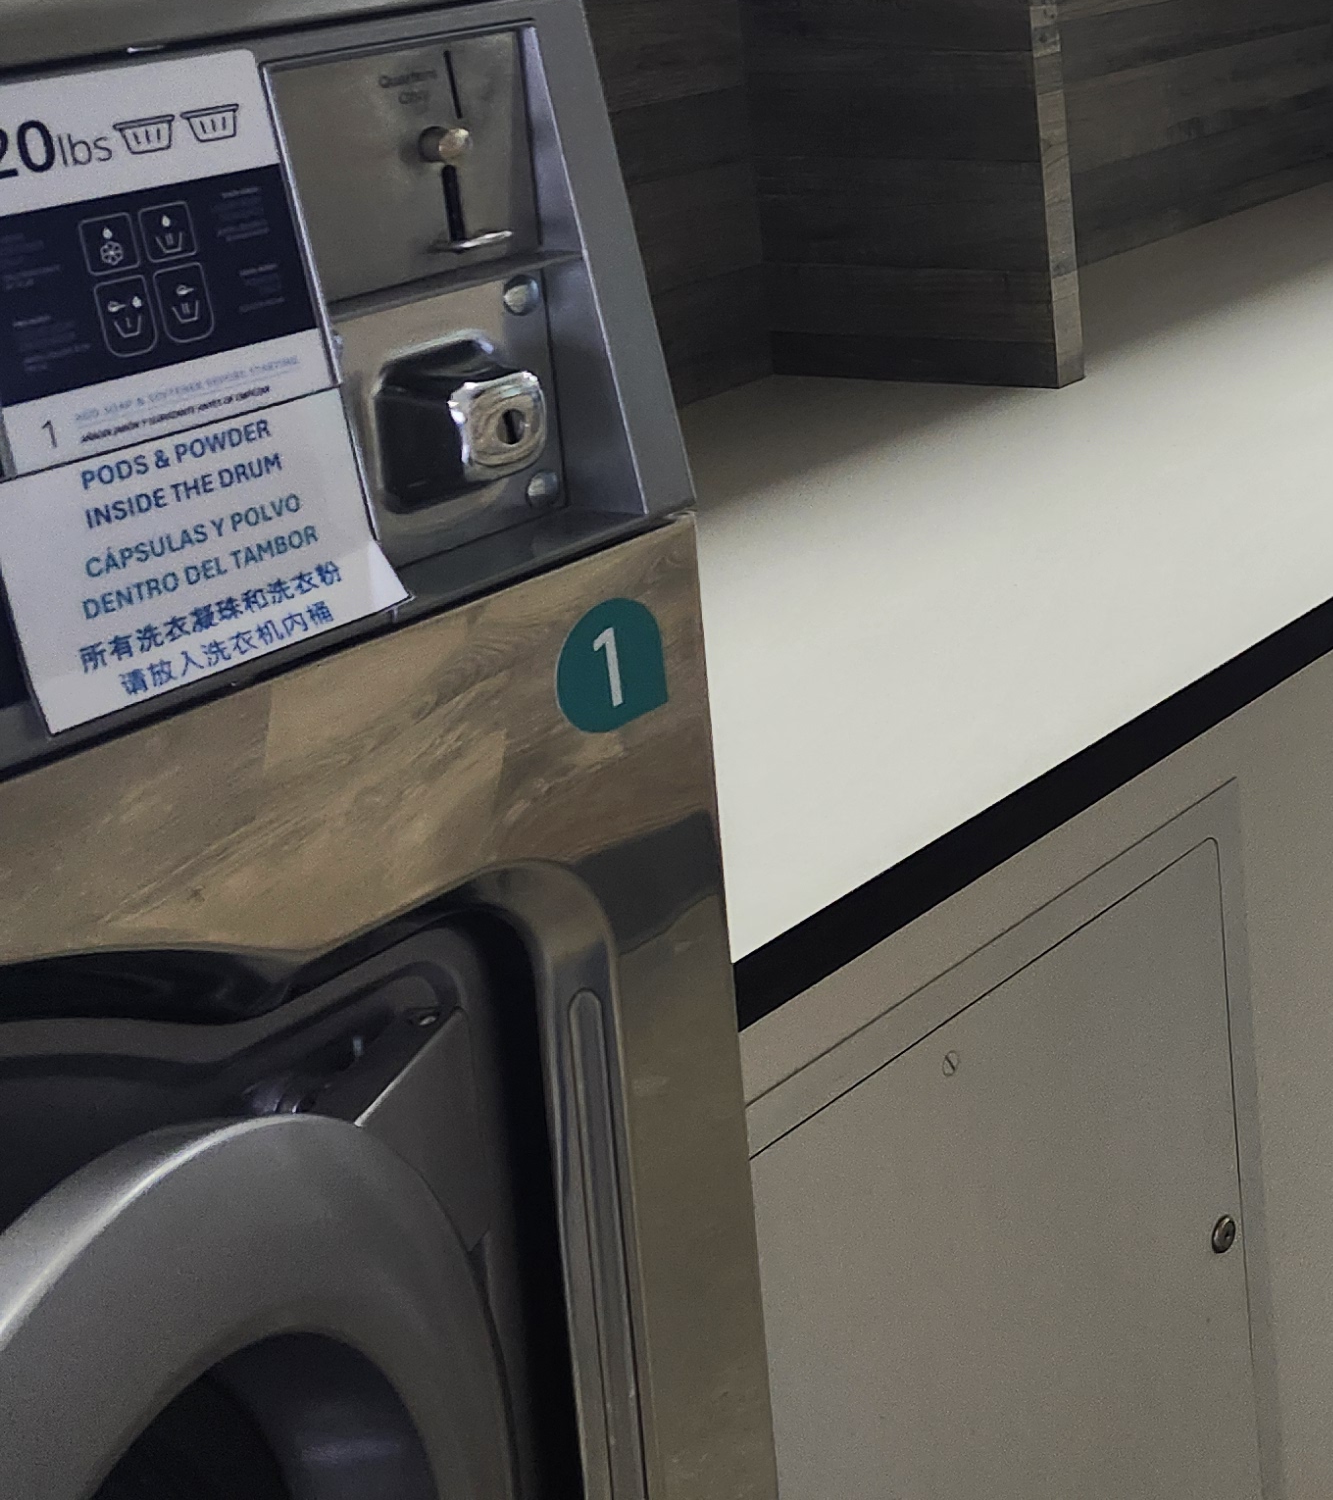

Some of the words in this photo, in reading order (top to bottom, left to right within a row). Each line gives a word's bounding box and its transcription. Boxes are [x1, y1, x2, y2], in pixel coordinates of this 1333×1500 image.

[41, 420, 57, 447] 1
[81, 454, 150, 490] PODS
[154, 449, 170, 469] &
[174, 419, 272, 463] POWDER
[85, 488, 169, 529] INSIDE
[170, 473, 215, 502] THE
[218, 452, 283, 488] DRUM
[82, 572, 180, 620] DENTRO
[184, 558, 228, 586] DEL
[229, 525, 320, 570] TAMBOR
[85, 524, 209, 577] CÁPSULAS
[210, 517, 225, 537] Y
[230, 493, 302, 532] POLVO
[78, 560, 343, 674] 所有洗衣凝珠和洗衣粉
[118, 600, 335, 696] 请放入洗衣机内桶
[593, 627, 624, 707] 1
